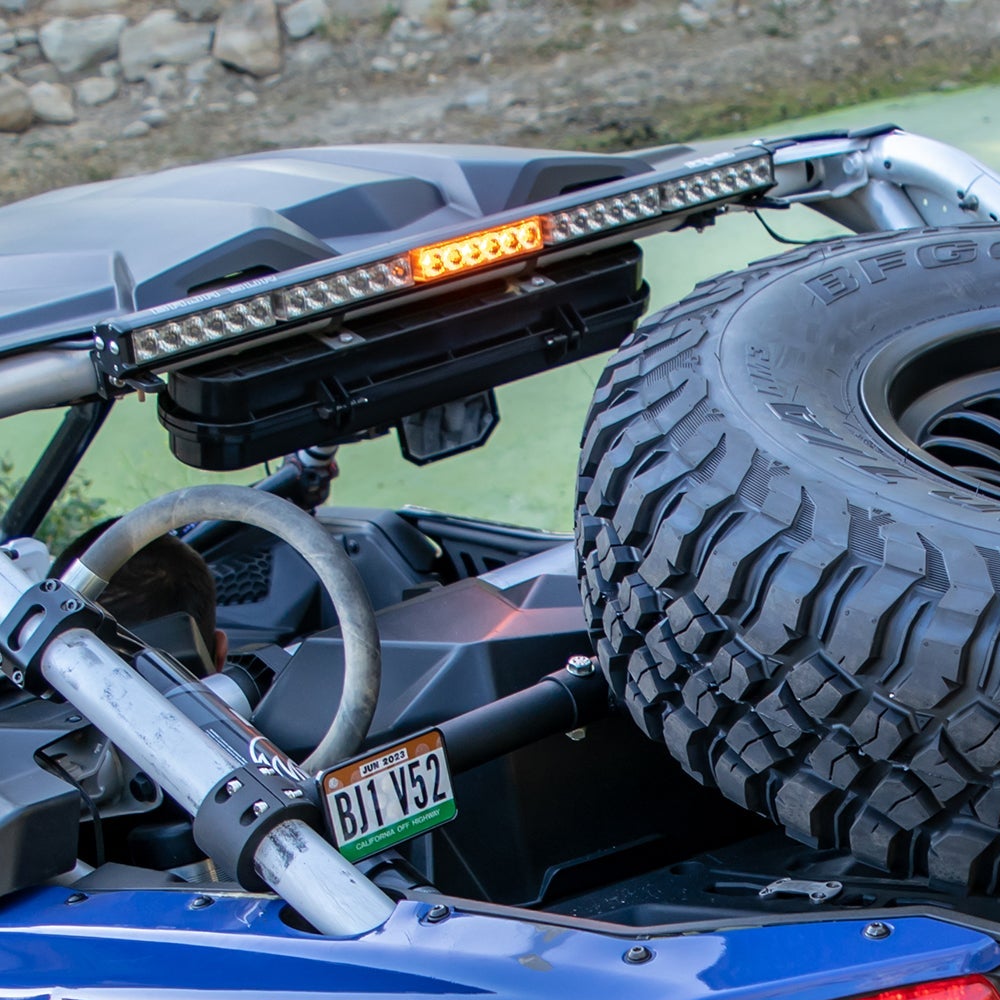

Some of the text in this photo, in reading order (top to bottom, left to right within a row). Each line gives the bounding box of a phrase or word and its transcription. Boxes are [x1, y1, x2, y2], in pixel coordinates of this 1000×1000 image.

[362, 750, 406, 775] JUN 2023
[334, 778, 384, 842] BJ1
[389, 753, 447, 816] V52
[355, 808, 441, 851] CALIFORNIA OFF HIGHWAY
